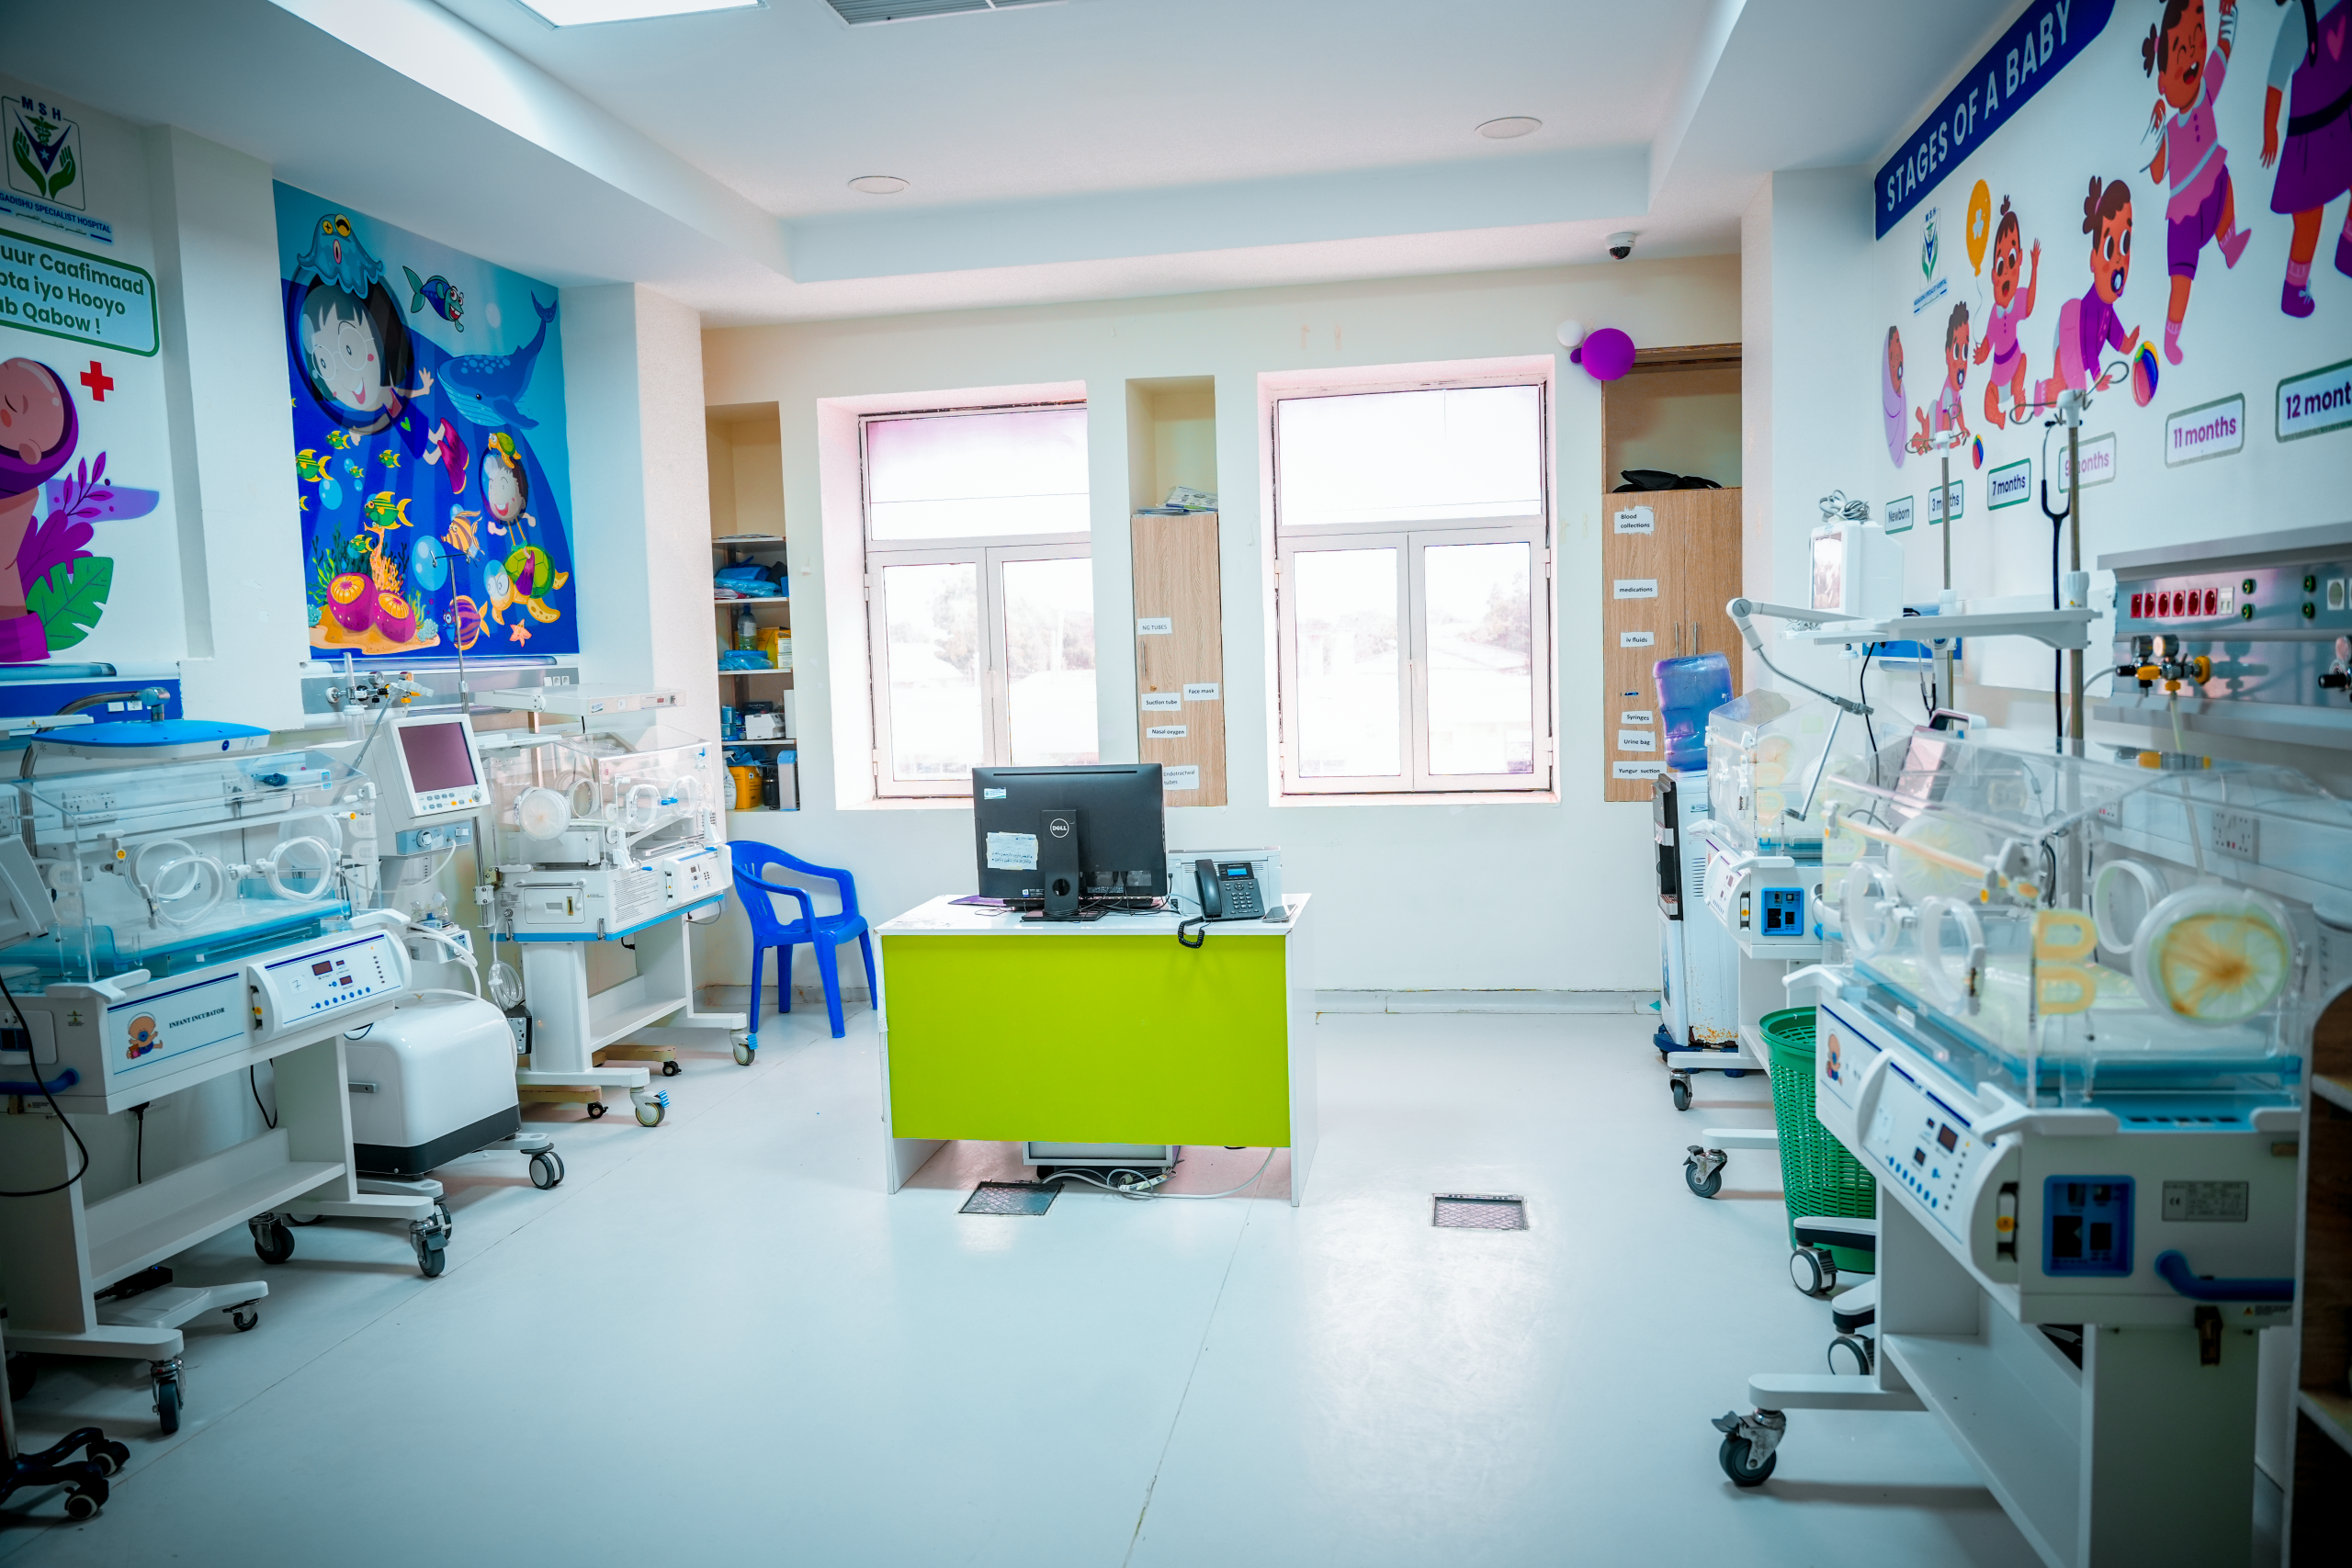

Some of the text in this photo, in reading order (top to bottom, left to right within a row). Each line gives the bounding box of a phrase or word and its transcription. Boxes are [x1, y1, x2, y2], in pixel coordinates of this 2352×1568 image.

[1887, 0, 2071, 211] STAGES OF A BABY
[34, 203, 76, 222] SPECIALIST
[77, 216, 112, 234] HOSPITAL
[40, 253, 144, 296] Caafimaad
[34, 275, 63, 302] iyo
[67, 286, 126, 318] Hooyo
[22, 301, 91, 333] Qabow
[2286, 394, 2301, 420] 12
[2174, 415, 2236, 449] 11 months
[2075, 450, 2109, 473] onths
[1992, 474, 2026, 497] 7 months
[1888, 507, 1910, 524] Newborn
[1931, 492, 1960, 513] 3 mths
[169, 1007, 225, 1029] INFANT INCUBATOR
